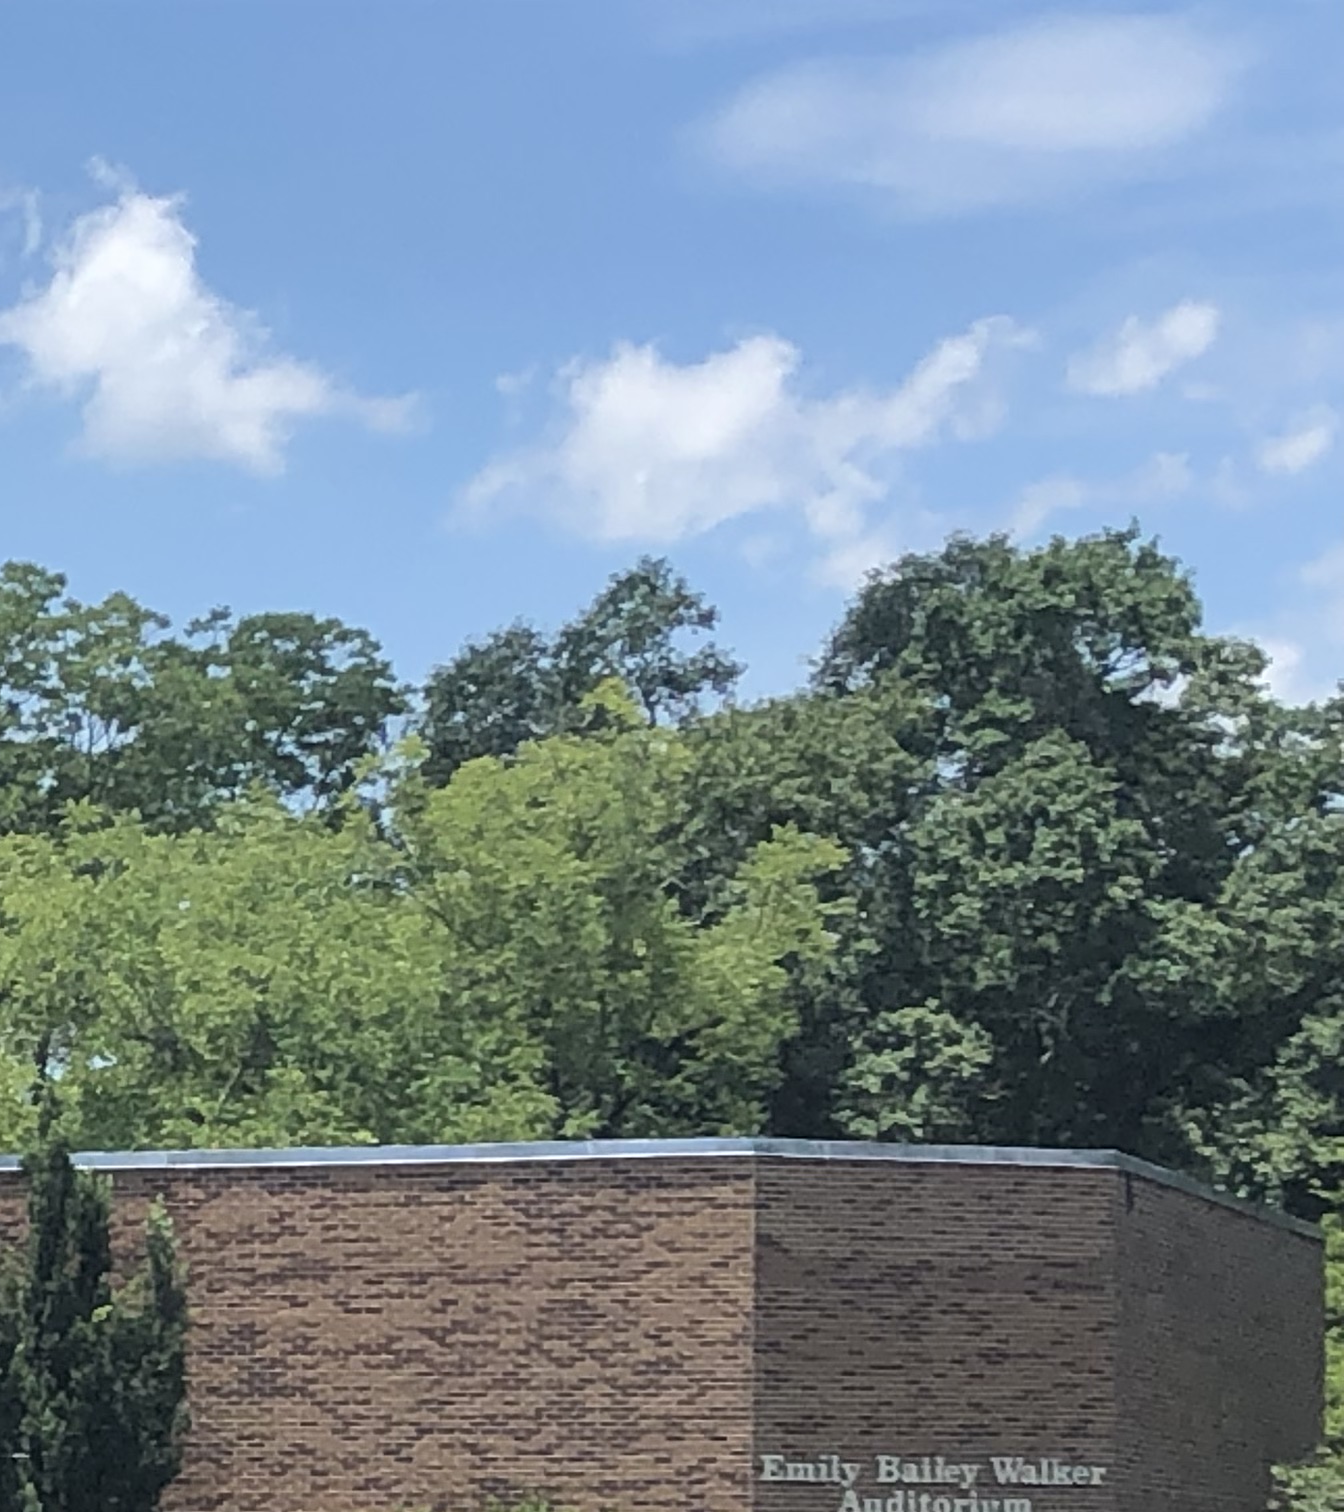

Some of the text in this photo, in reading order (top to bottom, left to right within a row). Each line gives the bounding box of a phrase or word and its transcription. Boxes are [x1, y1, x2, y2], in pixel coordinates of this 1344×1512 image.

[758, 1454, 1107, 1488] Emily Bailey Walker
